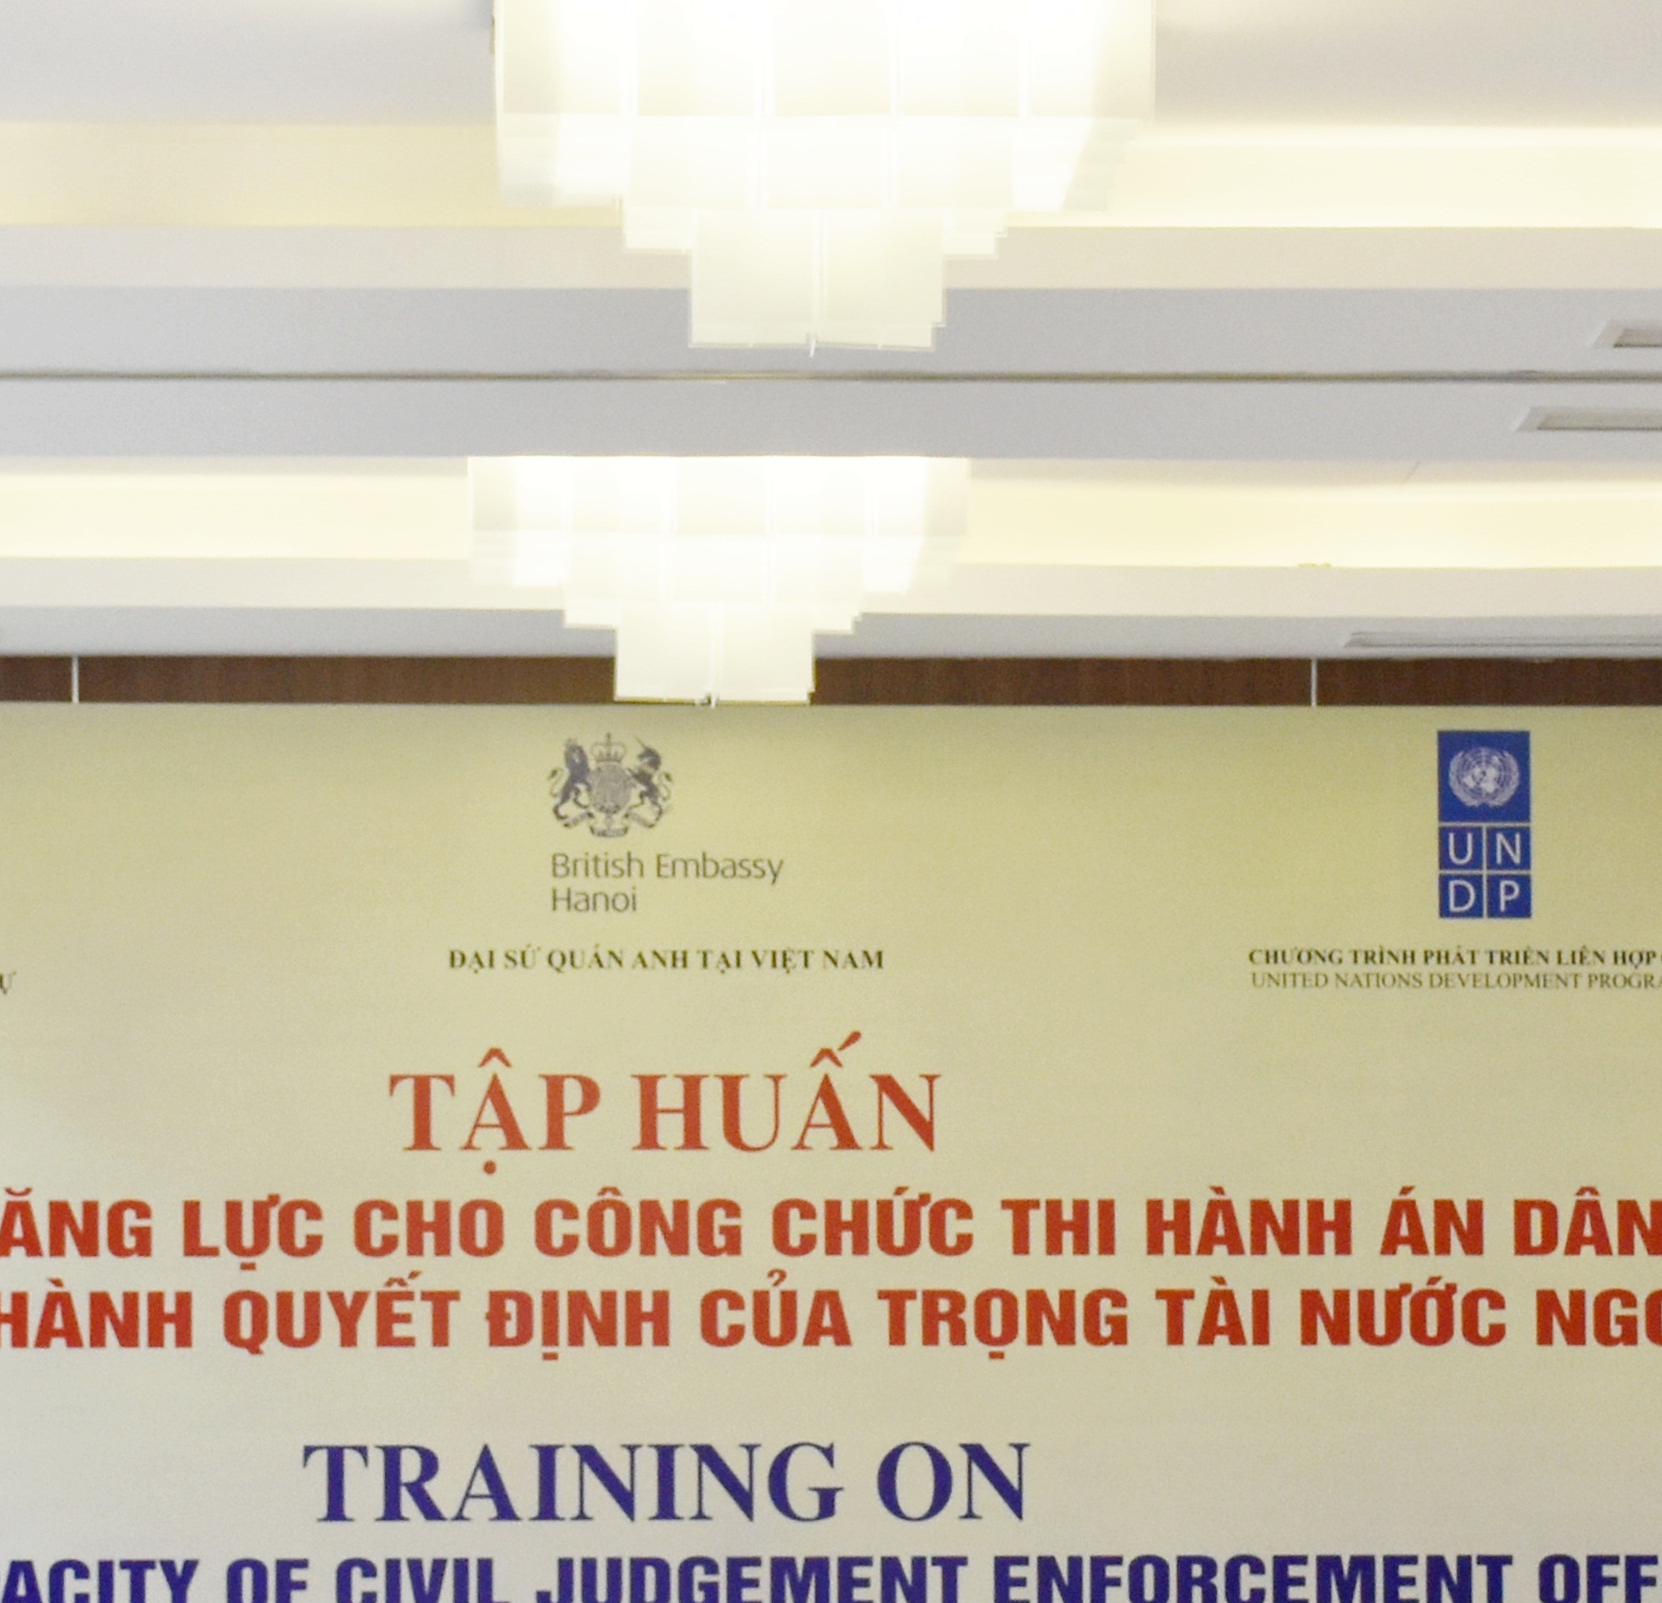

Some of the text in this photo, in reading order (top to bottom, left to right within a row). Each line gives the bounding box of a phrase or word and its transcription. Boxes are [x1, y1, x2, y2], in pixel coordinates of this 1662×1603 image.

[551, 850, 785, 886] British Embassy
[551, 887, 637, 913] Hanoi
[546, 943, 624, 974] QUÁN
[632, 949, 688, 970] ANH
[696, 949, 742, 975] TẠI
[750, 947, 814, 975] VIỆT
[823, 949, 884, 970] NAM
[1350, 945, 1416, 966] TRÌNH
[1423, 945, 1478, 966] PHÁT
[1251, 972, 1330, 989] UNITED
[1334, 972, 1423, 990] NATIONS
[1429, 972, 1582, 990] DEVELOPMENT
[389, 1030, 941, 1175] TẬP HUẤN
[183, 1194, 323, 1270] LỰC
[354, 1199, 504, 1257] CHO
[535, 1187, 741, 1257] CÔNG
[770, 1186, 973, 1257] CHỨC
[1001, 1199, 1115, 1256] THI
[1146, 1186, 1352, 1256] HÀNH
[1380, 1186, 1484, 1256] ÁN
[224, 1271, 460, 1355] QUYẾT
[485, 1290, 669, 1360] ĐỊNH
[701, 1269, 851, 1348] CỦA
[877, 1288, 1128, 1360] TRỌNG
[1155, 1276, 1270, 1347] TÀI
[1300, 1276, 1506, 1347] NƯỚC
[303, 1441, 1029, 1523] TRAINING ON
